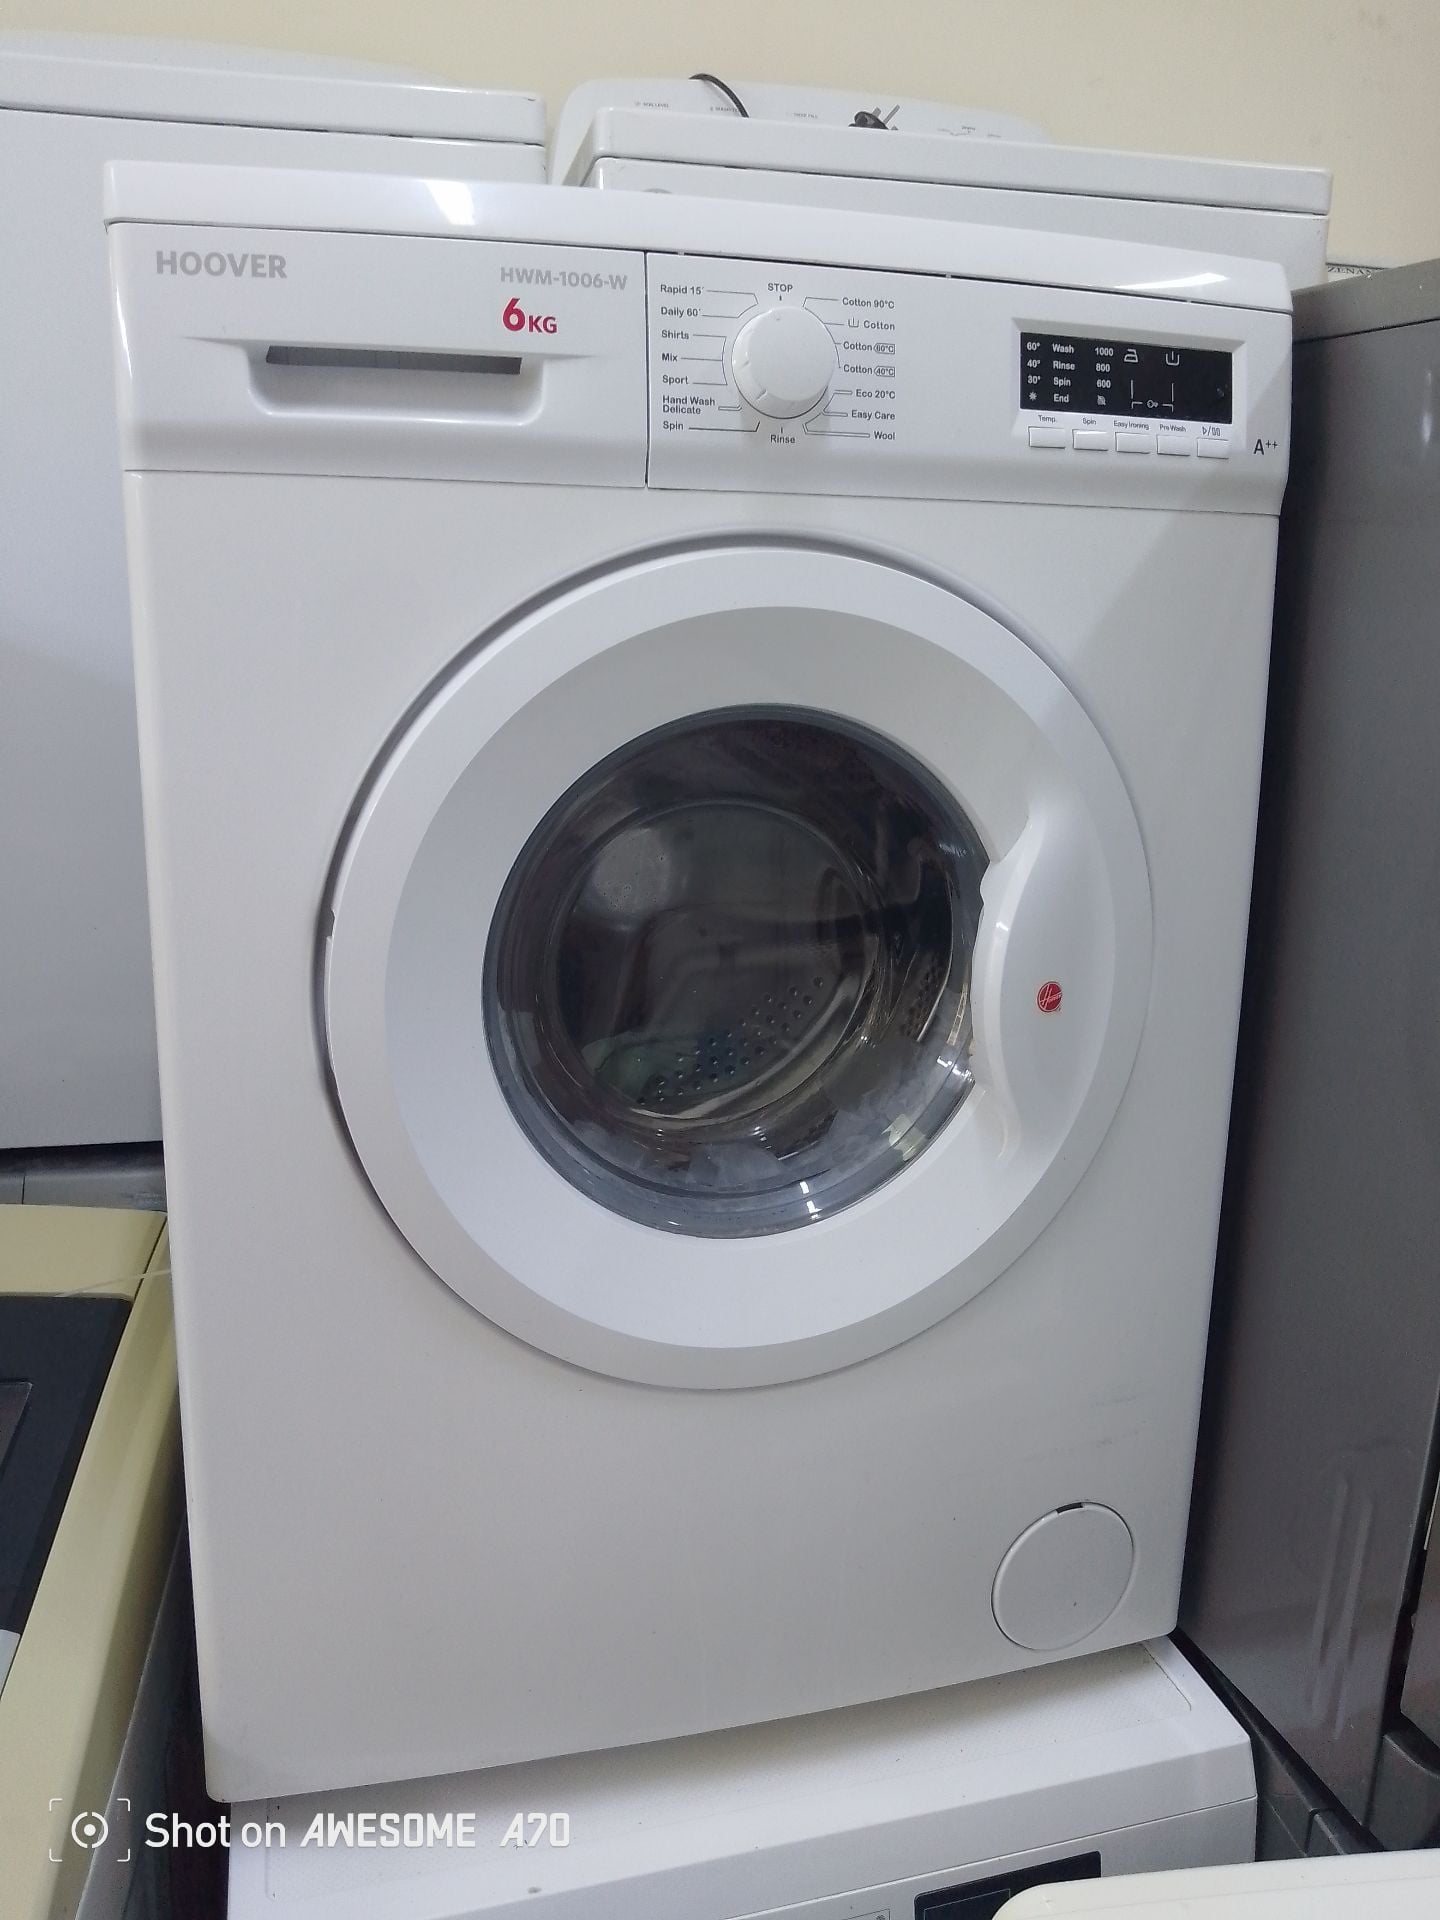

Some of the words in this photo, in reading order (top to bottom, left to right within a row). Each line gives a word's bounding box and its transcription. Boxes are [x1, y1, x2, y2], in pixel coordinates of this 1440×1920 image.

[155, 250, 287, 278] HOOVER
[500, 267, 627, 291] HWM-1006-W
[660, 285, 687, 295] Rapid
[768, 283, 793, 292] STOP
[842, 298, 871, 307] Cotton
[874, 300, 895, 309] 90°C
[661, 307, 684, 318] Daily
[863, 321, 895, 330] Cotton
[661, 330, 689, 339] Shirts
[843, 342, 873, 351] Cotton
[1052, 344, 1074, 354] Wash
[1095, 347, 1114, 357] 1000
[662, 353, 678, 362] Mix
[843, 365, 873, 374] Cotton
[876, 367, 894, 376] 40°C
[1053, 361, 1075, 371] Rinse
[1096, 363, 1110, 372] 800
[663, 375, 688, 386] Sport
[1053, 377, 1071, 387] Spin
[1097, 379, 1111, 388] 600
[856, 389, 872, 398] Eco
[875, 391, 895, 399] 20°C
[1053, 394, 1069, 403] End
[663, 396, 685, 404] Hand
[687, 397, 715, 406] Wash
[663, 405, 701, 414] Delicate
[851, 411, 872, 420] Easy
[875, 411, 895, 420] Care
[663, 421, 683, 431] Spin
[1114, 420, 1127, 428] Easy
[1129, 422, 1149, 430] Ironing
[1170, 425, 1186, 433] Wash
[770, 435, 796, 444] Rinse
[874, 431, 895, 440] Wool
[1253, 439, 1278, 455] A++
